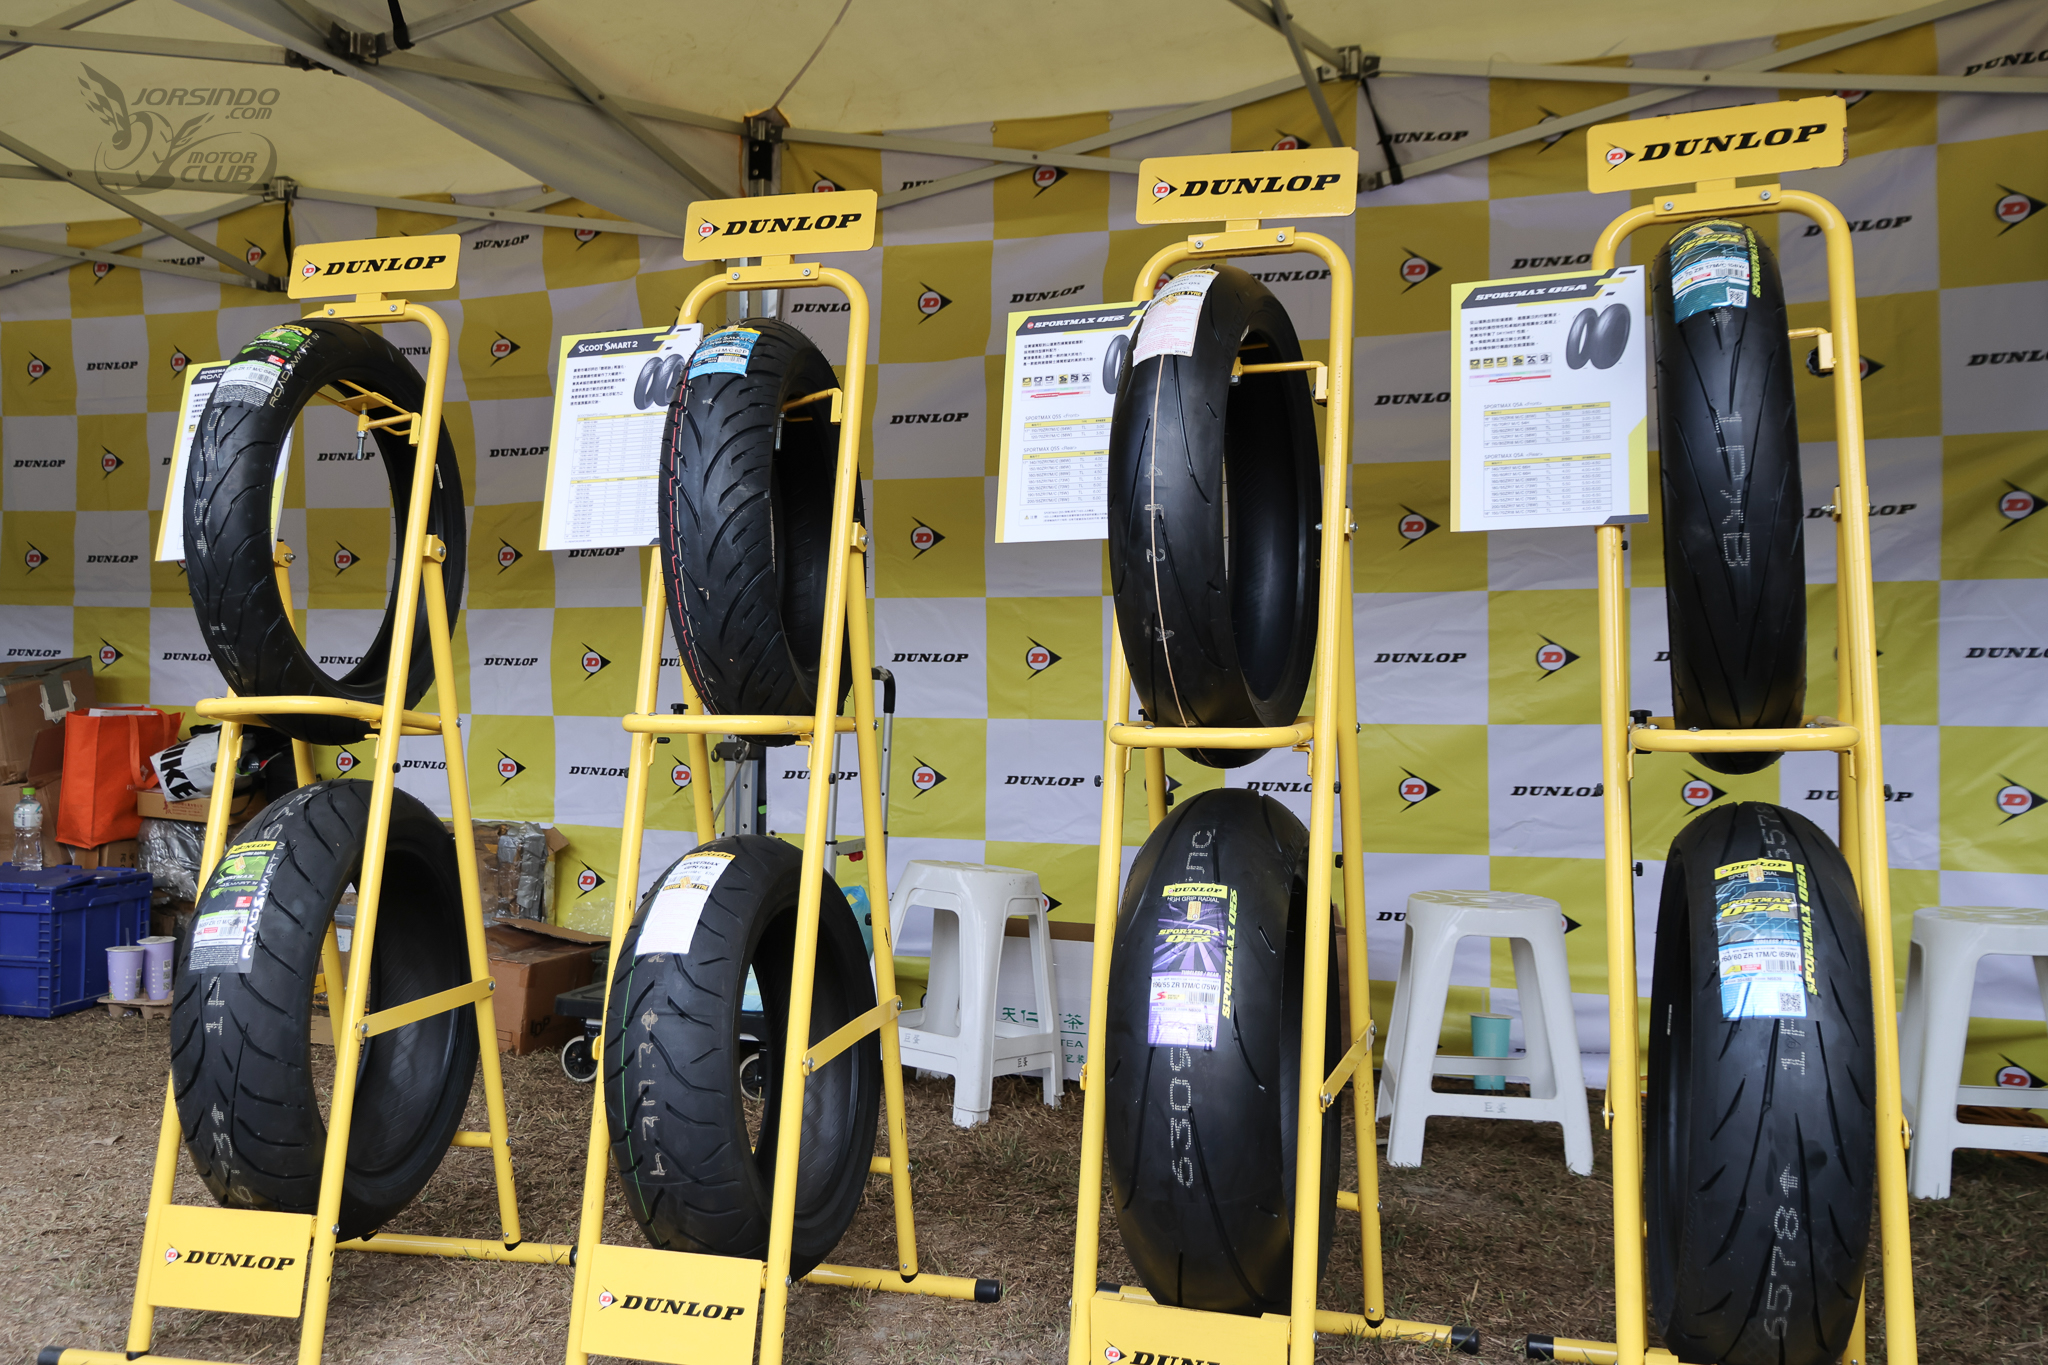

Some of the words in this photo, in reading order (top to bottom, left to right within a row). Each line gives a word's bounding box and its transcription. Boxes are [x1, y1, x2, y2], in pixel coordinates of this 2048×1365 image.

[1638, 123, 1828, 162] DUNLOP
[1179, 174, 1341, 198] DUNLOP
[722, 213, 862, 236] DUNLOP
[473, 234, 530, 250] DUNLOP
[322, 255, 447, 276] DUNLOP
[1009, 284, 1085, 303] DUNLOP
[1474, 287, 1545, 301] SPORTMAX
[1034, 317, 1096, 328] SPORTMAX
[578, 344, 604, 353] SCOOT
[604, 341, 632, 351] SMART
[631, 340, 639, 348] 2
[86, 360, 138, 371] DUNLOP
[889, 412, 969, 424] DUNLOP
[489, 446, 549, 457] DUNLOP
[13, 459, 66, 468] DUNLOP
[568, 547, 625, 558] DUNLOP
[86, 555, 139, 564] DUNLOP
[6, 648, 61, 658] DUNLOP
[891, 653, 969, 663] DUNLOP
[1374, 652, 1467, 663] DUNLOP
[483, 657, 538, 667] DUNLOP
[402, 760, 448, 770] DUNLO
[1004, 775, 1085, 787] DUNLOP
[1719, 897, 1793, 910] SPORTMAX
[1158, 928, 1222, 937] SPORTMAX
[1221, 925, 1236, 1019] SPORTMAX
[1002, 1007, 1085, 1030] 天仁茶
[184, 1250, 295, 1271] DUNLOP
[620, 1294, 745, 1320] DUNLOP
